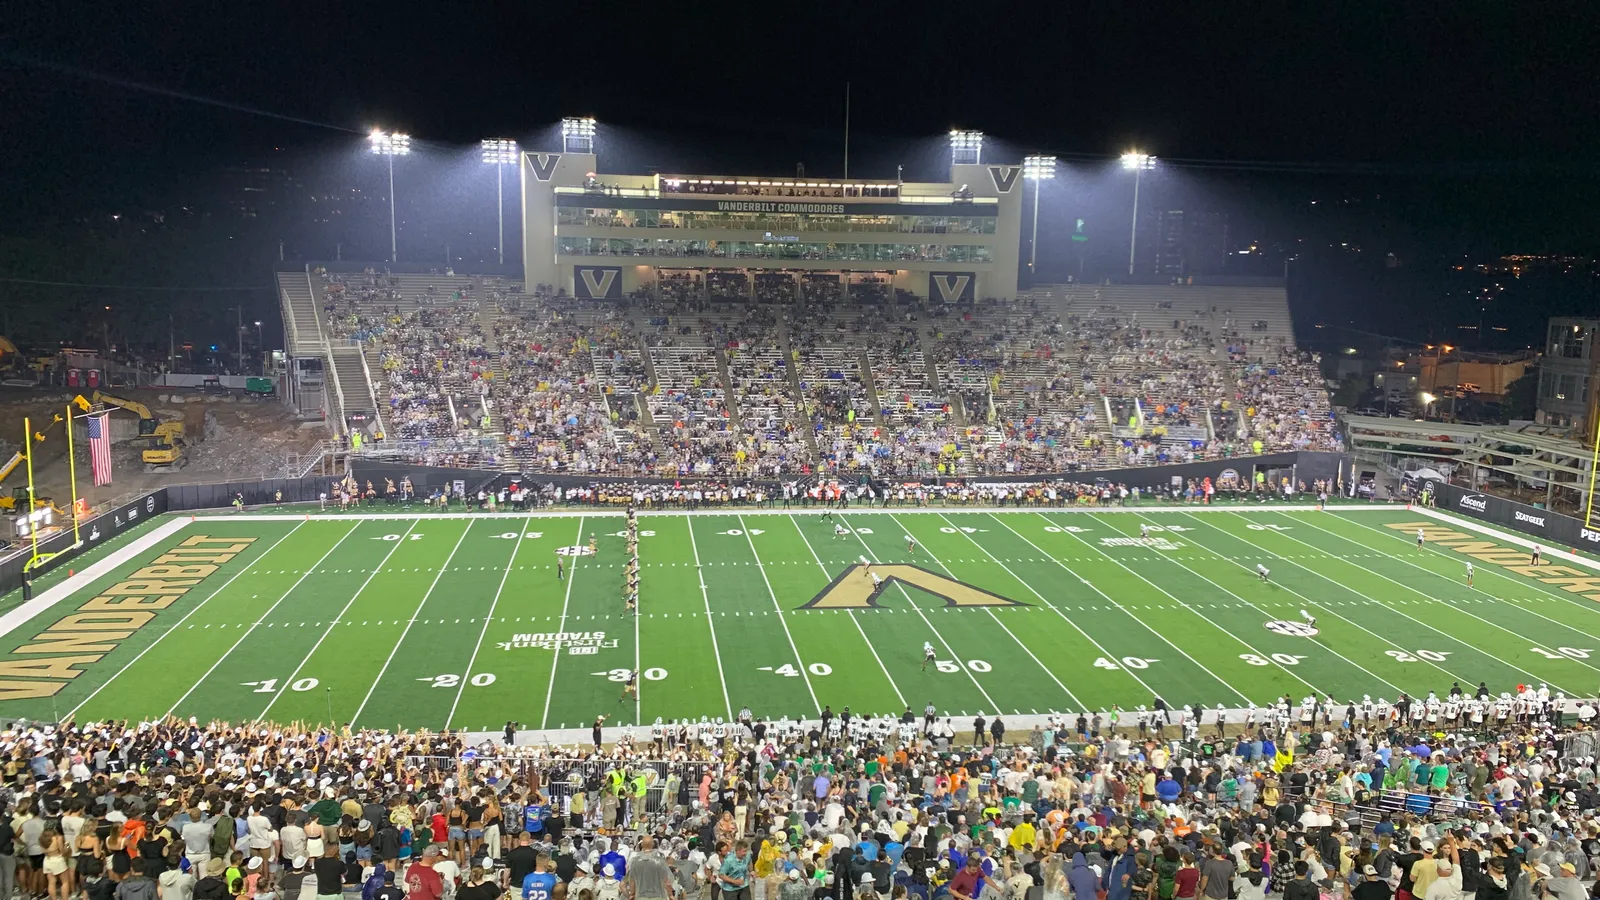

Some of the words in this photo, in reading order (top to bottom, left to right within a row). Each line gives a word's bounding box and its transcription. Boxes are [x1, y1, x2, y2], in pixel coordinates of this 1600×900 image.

[525, 153, 562, 181] V
[987, 166, 1022, 193] V
[718, 202, 776, 212] VANDERBILT
[778, 204, 845, 214] COMMODORES
[580, 270, 618, 298] V
[932, 275, 970, 303] V
[1460, 494, 1486, 509] Ascend
[1515, 511, 1545, 527] SEATGEEK
[382, 533, 424, 541] 10
[500, 531, 544, 540] 20
[793, 564, 1038, 610] V
[0, 534, 258, 700] VANDERBILT
[494, 638, 620, 650] FirstBank
[512, 632, 606, 642] STADIUM
[1239, 653, 1300, 666] 30
[1384, 650, 1447, 662] 20
[1530, 646, 1591, 659] 10
[774, 662, 832, 677] 40
[936, 660, 992, 674] 50
[1093, 656, 1150, 670] 40
[431, 672, 497, 688] 20
[608, 667, 668, 683] 30
[253, 677, 320, 693] 10
[528, 890, 548, 900] 22
